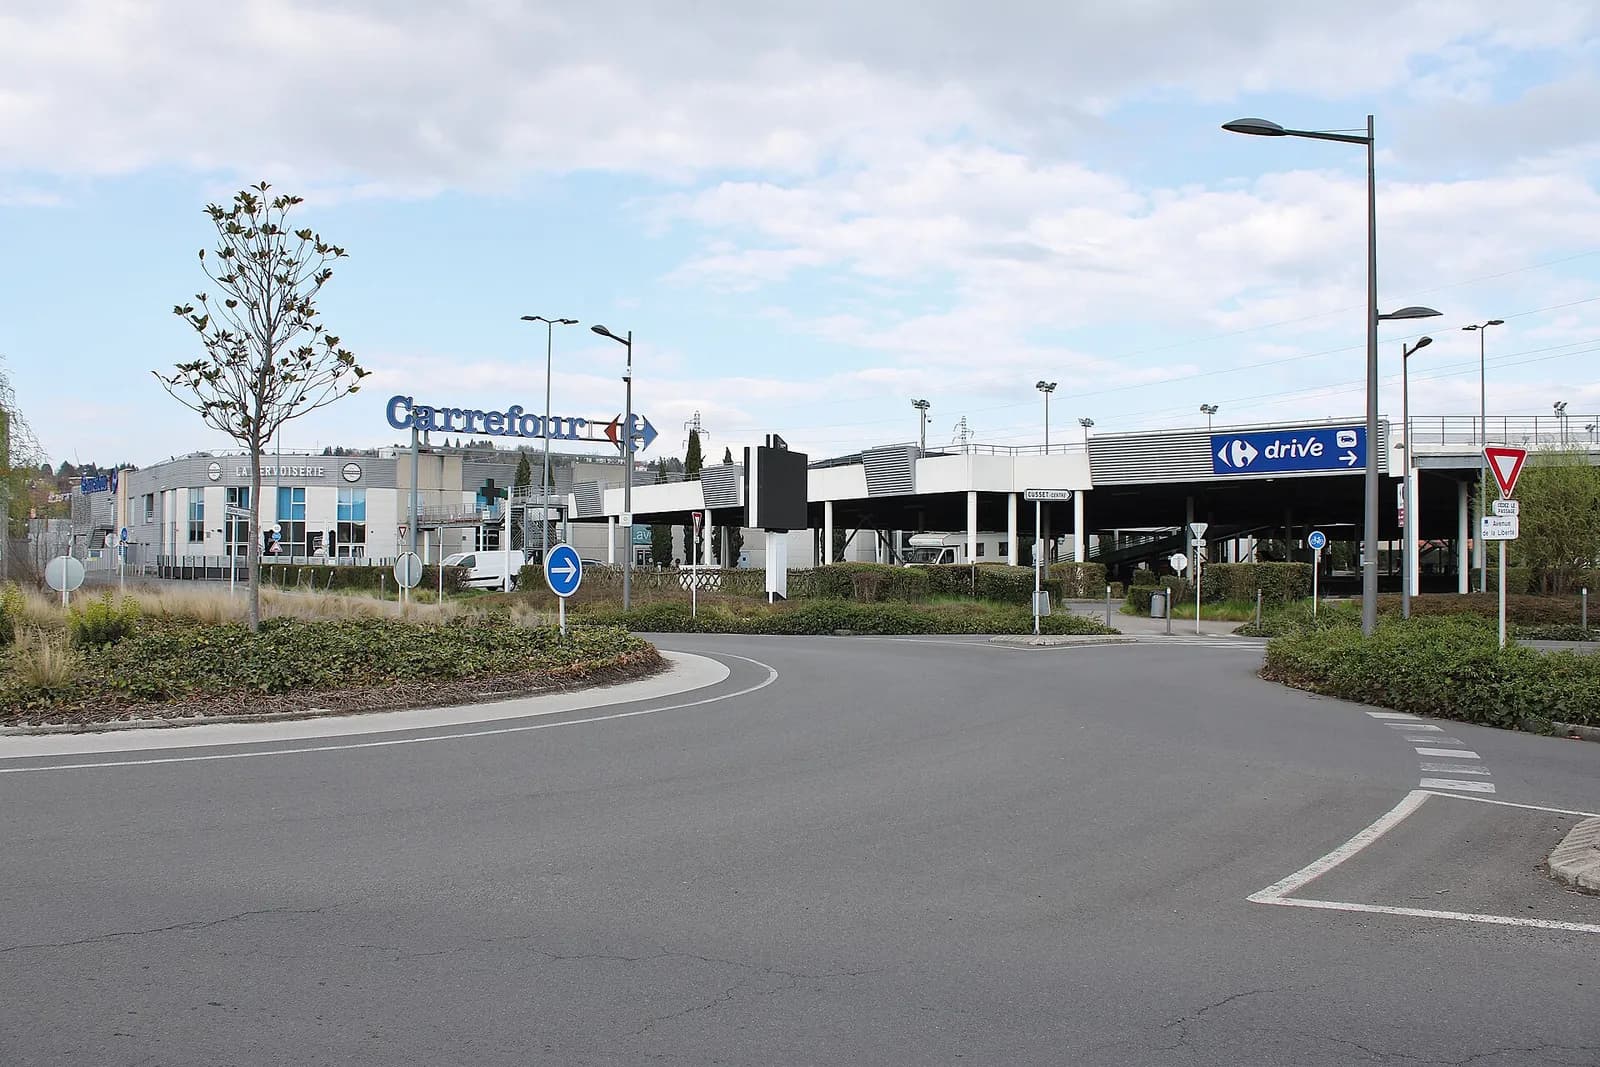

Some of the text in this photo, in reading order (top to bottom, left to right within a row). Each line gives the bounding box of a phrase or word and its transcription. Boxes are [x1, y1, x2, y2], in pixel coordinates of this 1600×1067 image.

[386, 394, 586, 440] Carrefour
[1264, 437, 1325, 460] drive
[235, 466, 248, 477] LA
[259, 465, 324, 477] ERVOISERIE
